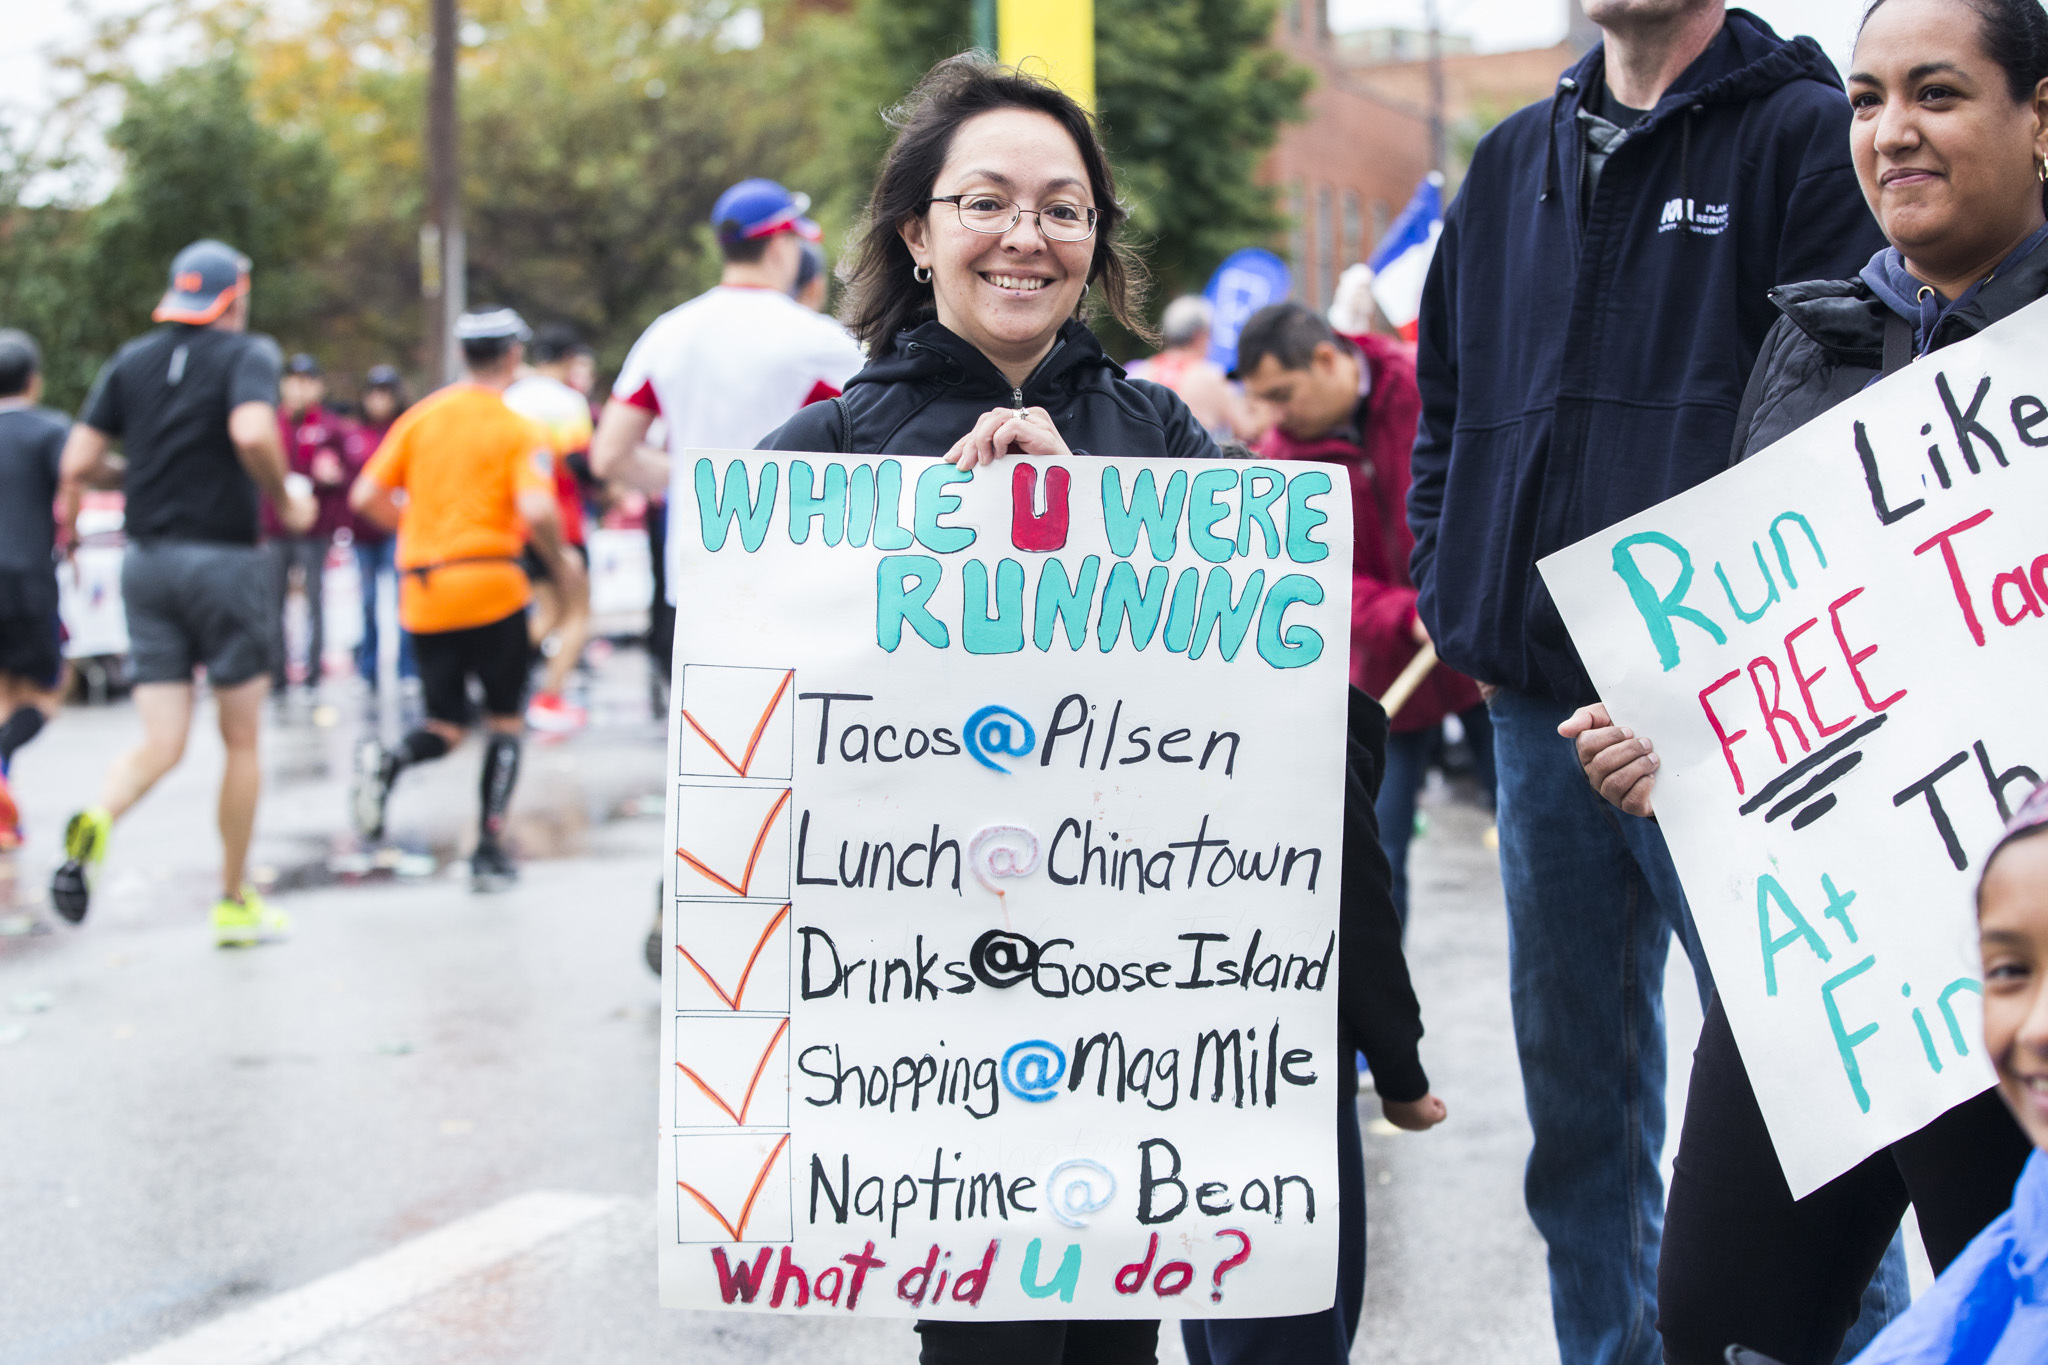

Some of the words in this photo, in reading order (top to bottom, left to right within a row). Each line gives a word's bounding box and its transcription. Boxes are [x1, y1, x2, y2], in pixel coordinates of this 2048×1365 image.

[694, 459, 978, 553] WHILE
[1011, 462, 1072, 553] U
[1101, 465, 1334, 563] WERE
[875, 554, 1325, 669] RUNNING
[1611, 510, 1829, 673] Run
[798, 692, 961, 765] Tacos
[962, 704, 1037, 775] @
[1040, 693, 1242, 780] Pilsen
[1698, 586, 1909, 796] FREE
[796, 809, 962, 897] Lunch
[967, 824, 1043, 897] @
[1047, 814, 1323, 895] Chinatown
[798, 926, 977, 1004] Drinks
[969, 929, 1040, 989] @
[1030, 938, 1173, 998] Goose
[1175, 929, 1336, 993] Island
[1756, 871, 1859, 998] At
[798, 1040, 1000, 1120] Shopping
[1000, 1039, 1067, 1103] @
[1189, 1016, 1318, 1109] Mile
[808, 1146, 1038, 1239] Naptime
[1045, 1158, 1117, 1229] @
[1135, 1138, 1316, 1226] Bean
[710, 1239, 886, 1311] What
[899, 1238, 1001, 1308] did
[1114, 1228, 1253, 1305] do?
